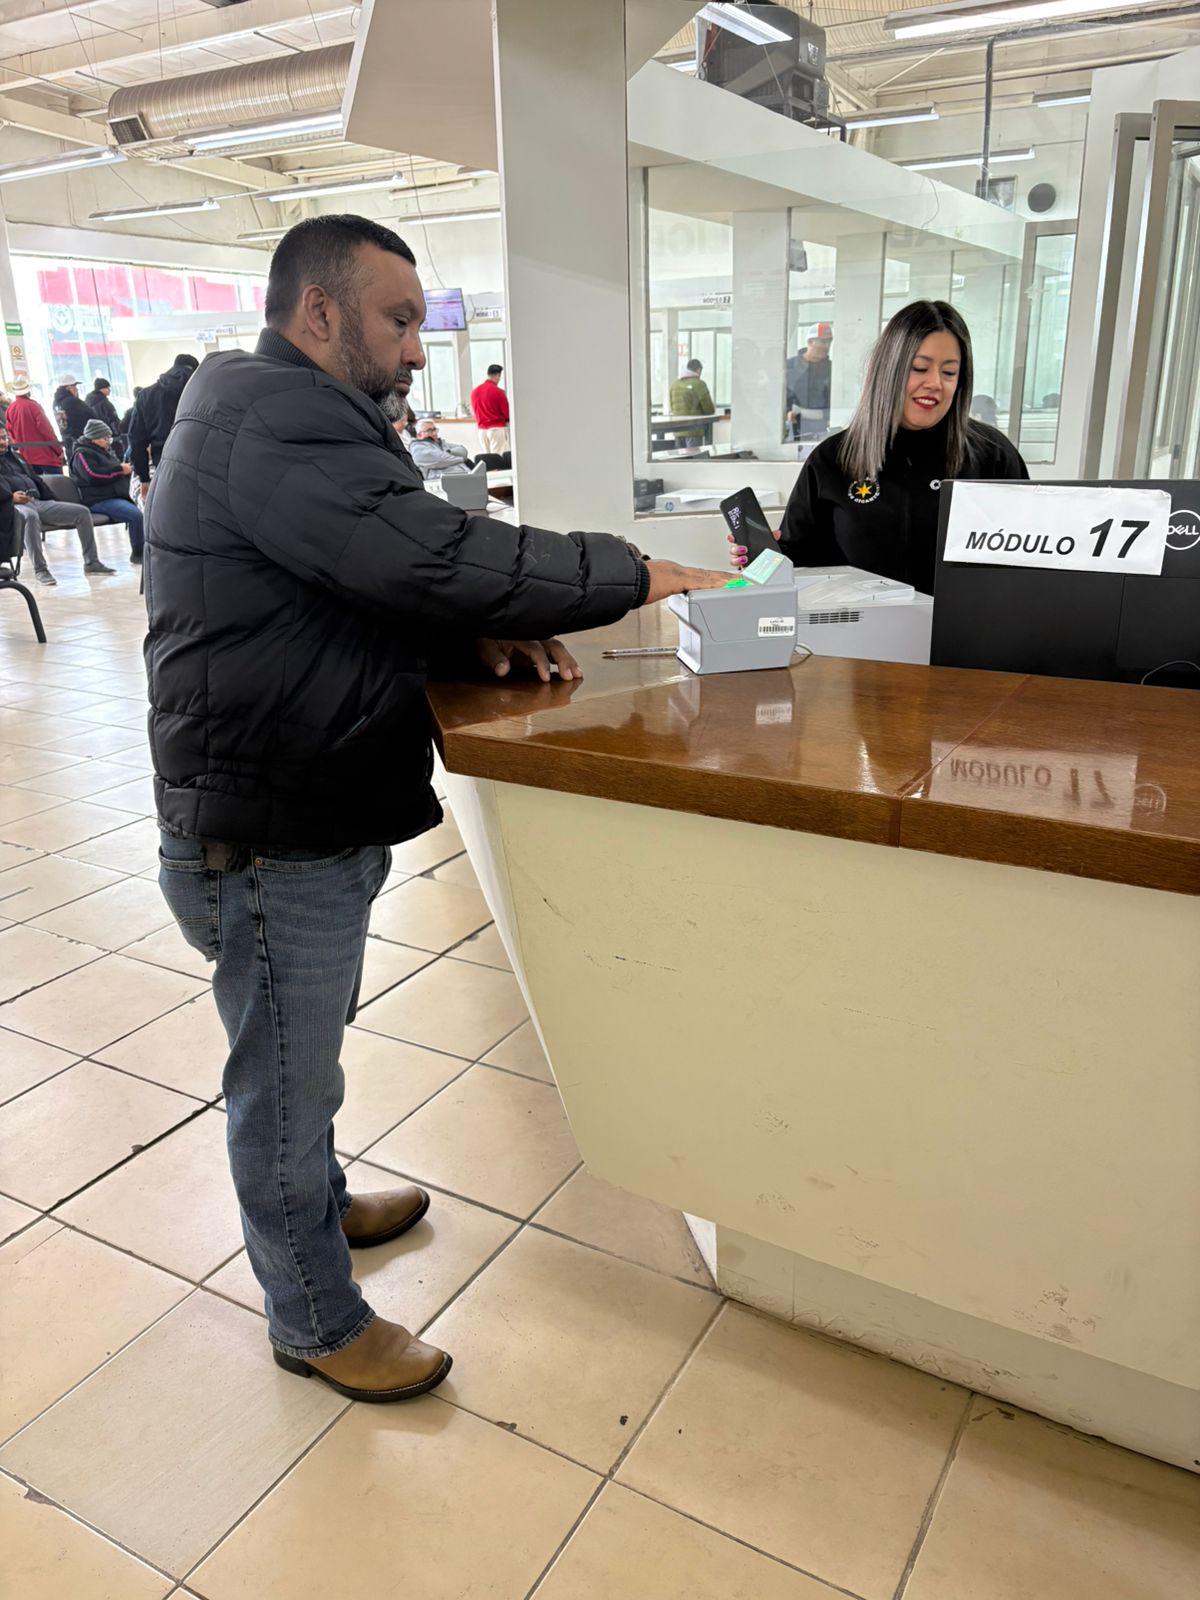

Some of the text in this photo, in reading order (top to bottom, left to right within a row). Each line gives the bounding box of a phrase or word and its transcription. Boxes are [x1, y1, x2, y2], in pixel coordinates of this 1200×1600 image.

[964, 518, 1151, 559] MÓDULO 17
[1168, 524, 1200, 536] DELL
